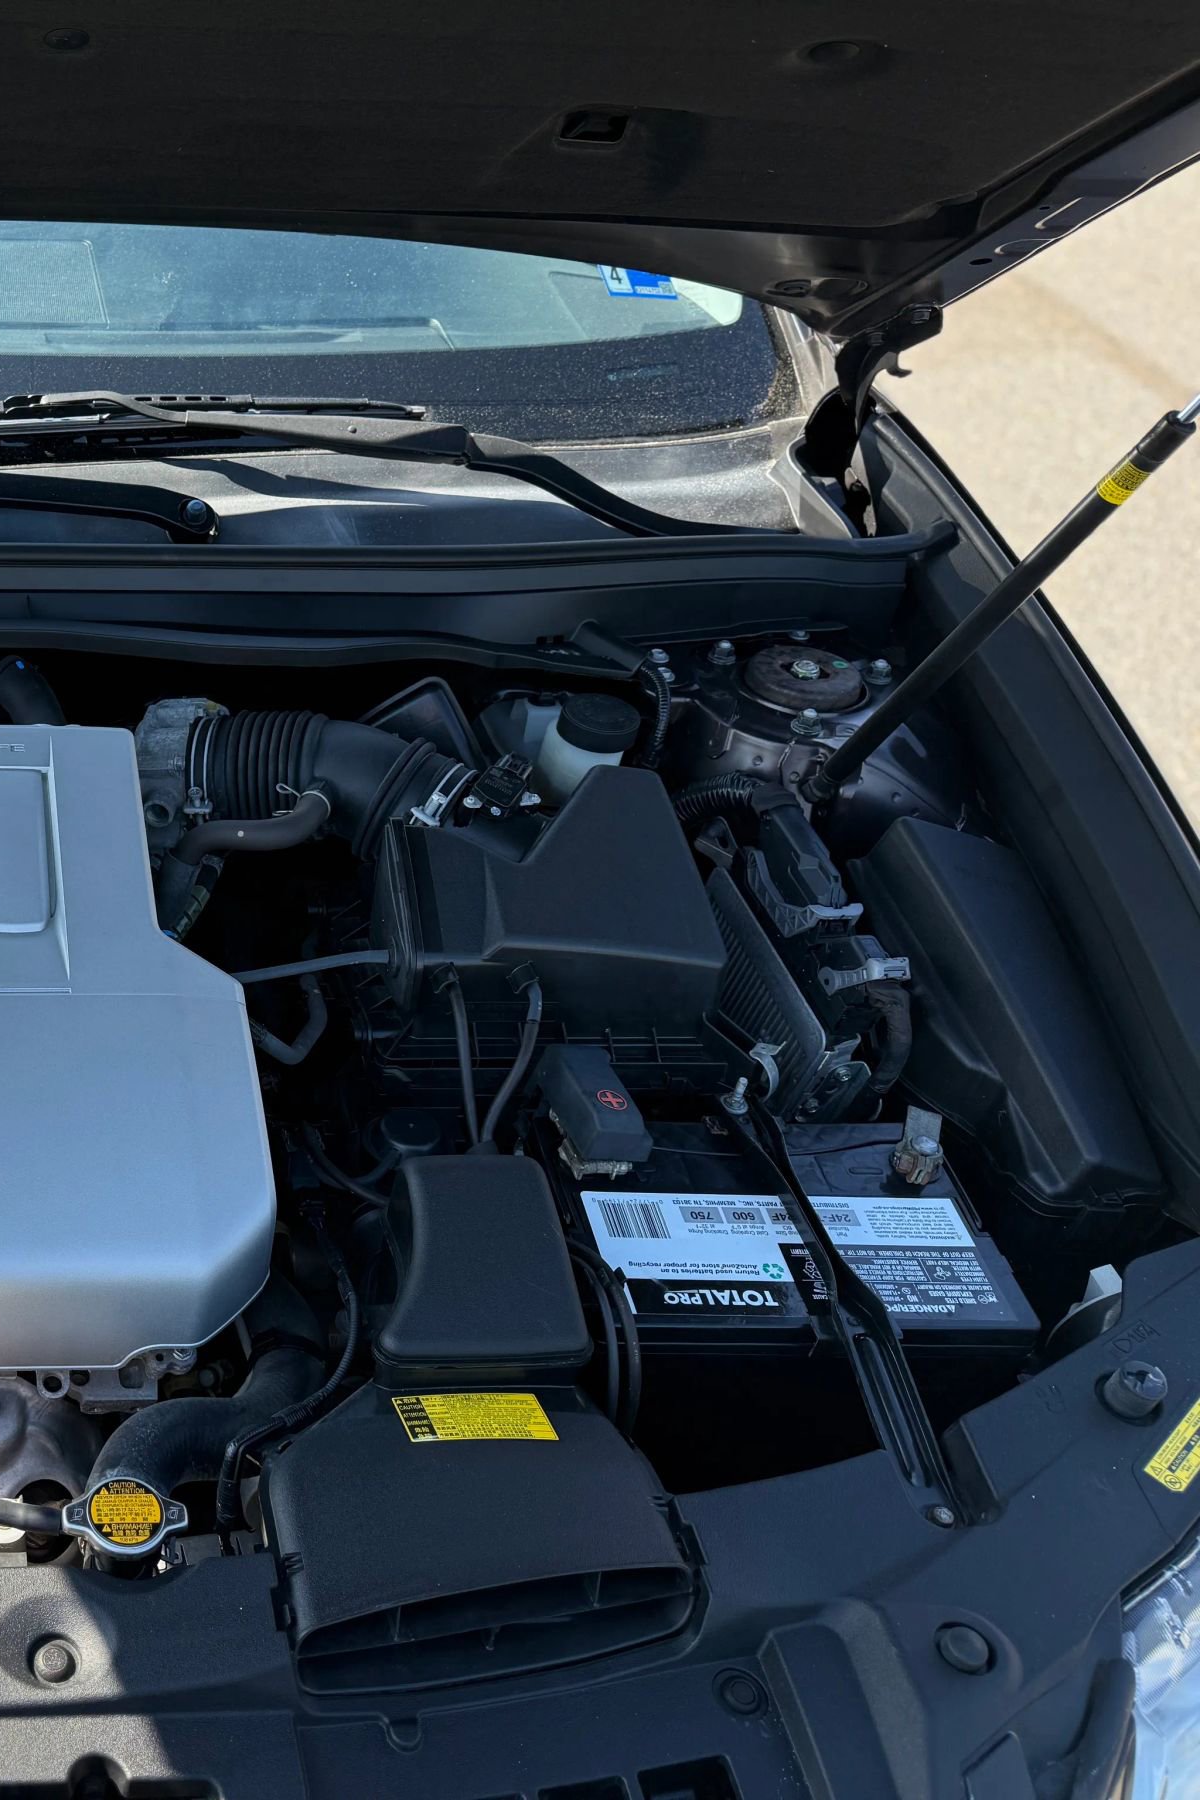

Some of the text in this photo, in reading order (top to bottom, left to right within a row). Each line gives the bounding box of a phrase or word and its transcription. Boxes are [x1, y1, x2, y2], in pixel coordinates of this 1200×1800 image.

[689, 1210, 714, 1221] 750
[732, 1211, 756, 1221] 600
[628, 1260, 662, 1268] recycling
[734, 1268, 761, 1276] Return
[906, 1294, 919, 1303] NO
[884, 1303, 949, 1313] DANGER/PO
[1173, 1449, 1189, 1468] CAUTION
